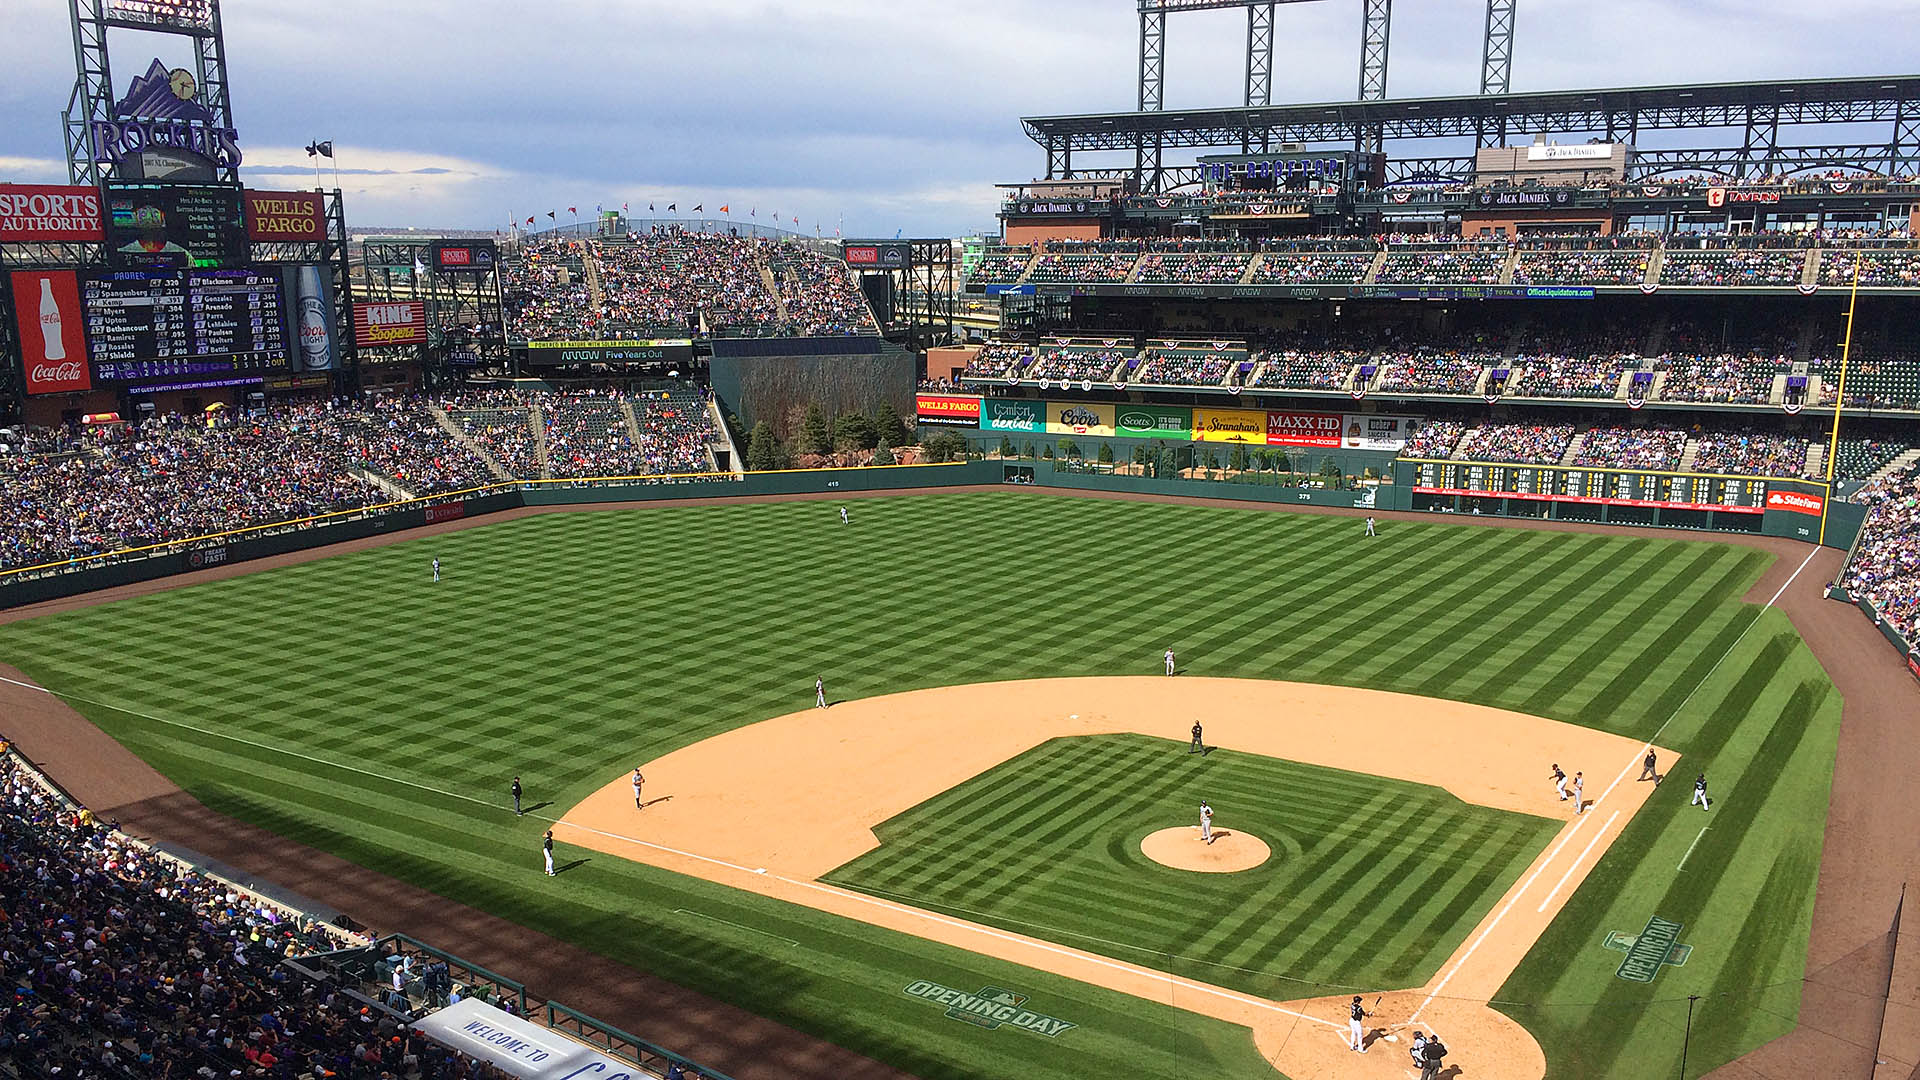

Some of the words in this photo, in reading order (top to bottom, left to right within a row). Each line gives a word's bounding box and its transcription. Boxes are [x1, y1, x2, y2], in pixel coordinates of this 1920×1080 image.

[89, 119, 242, 168] ROCKIES
[1197, 162, 1234, 179] THE
[1247, 159, 1338, 178] ROOFTOP
[1496, 192, 1518, 205] JACK
[1729, 190, 1781, 202] TAVERN
[0, 194, 98, 216] SPORTS
[252, 200, 315, 216] WELLS
[1031, 203, 1048, 214] JACK
[1, 217, 100, 231] AUTHORITY
[256, 218, 316, 233] FARGO
[101, 290, 148, 298] Spangenberg
[1527, 288, 1593, 297] OfficeLiquidators.com
[367, 305, 413, 325] KING
[106, 325, 149, 333] Bethancourt
[368, 325, 415, 343] Soopers
[606, 350, 624, 359] Five
[624, 350, 647, 358] Years
[648, 349, 663, 358] Out
[31, 361, 82, 382] Coca-Cola
[918, 401, 948, 410] WELLS
[950, 403, 979, 412] FARGO
[994, 402, 1030, 416] Comfort
[992, 413, 1035, 430] dental
[1060, 409, 1101, 426] Coors
[1124, 417, 1150, 426] Scotts
[1269, 416, 1315, 429] MAXX
[1318, 418, 1340, 430] HD
[1207, 417, 1260, 433] Stranahan's
[1269, 429, 1339, 437] sunglasses
[205, 553, 227, 564] FAST!
[1620, 937, 1669, 982] OPENING
[1646, 918, 1680, 940] DAY
[907, 981, 1016, 1020] OPENING
[1012, 1011, 1072, 1036] DAY
[463, 1020, 525, 1054] WELCOME
[526, 1049, 550, 1063] TO
